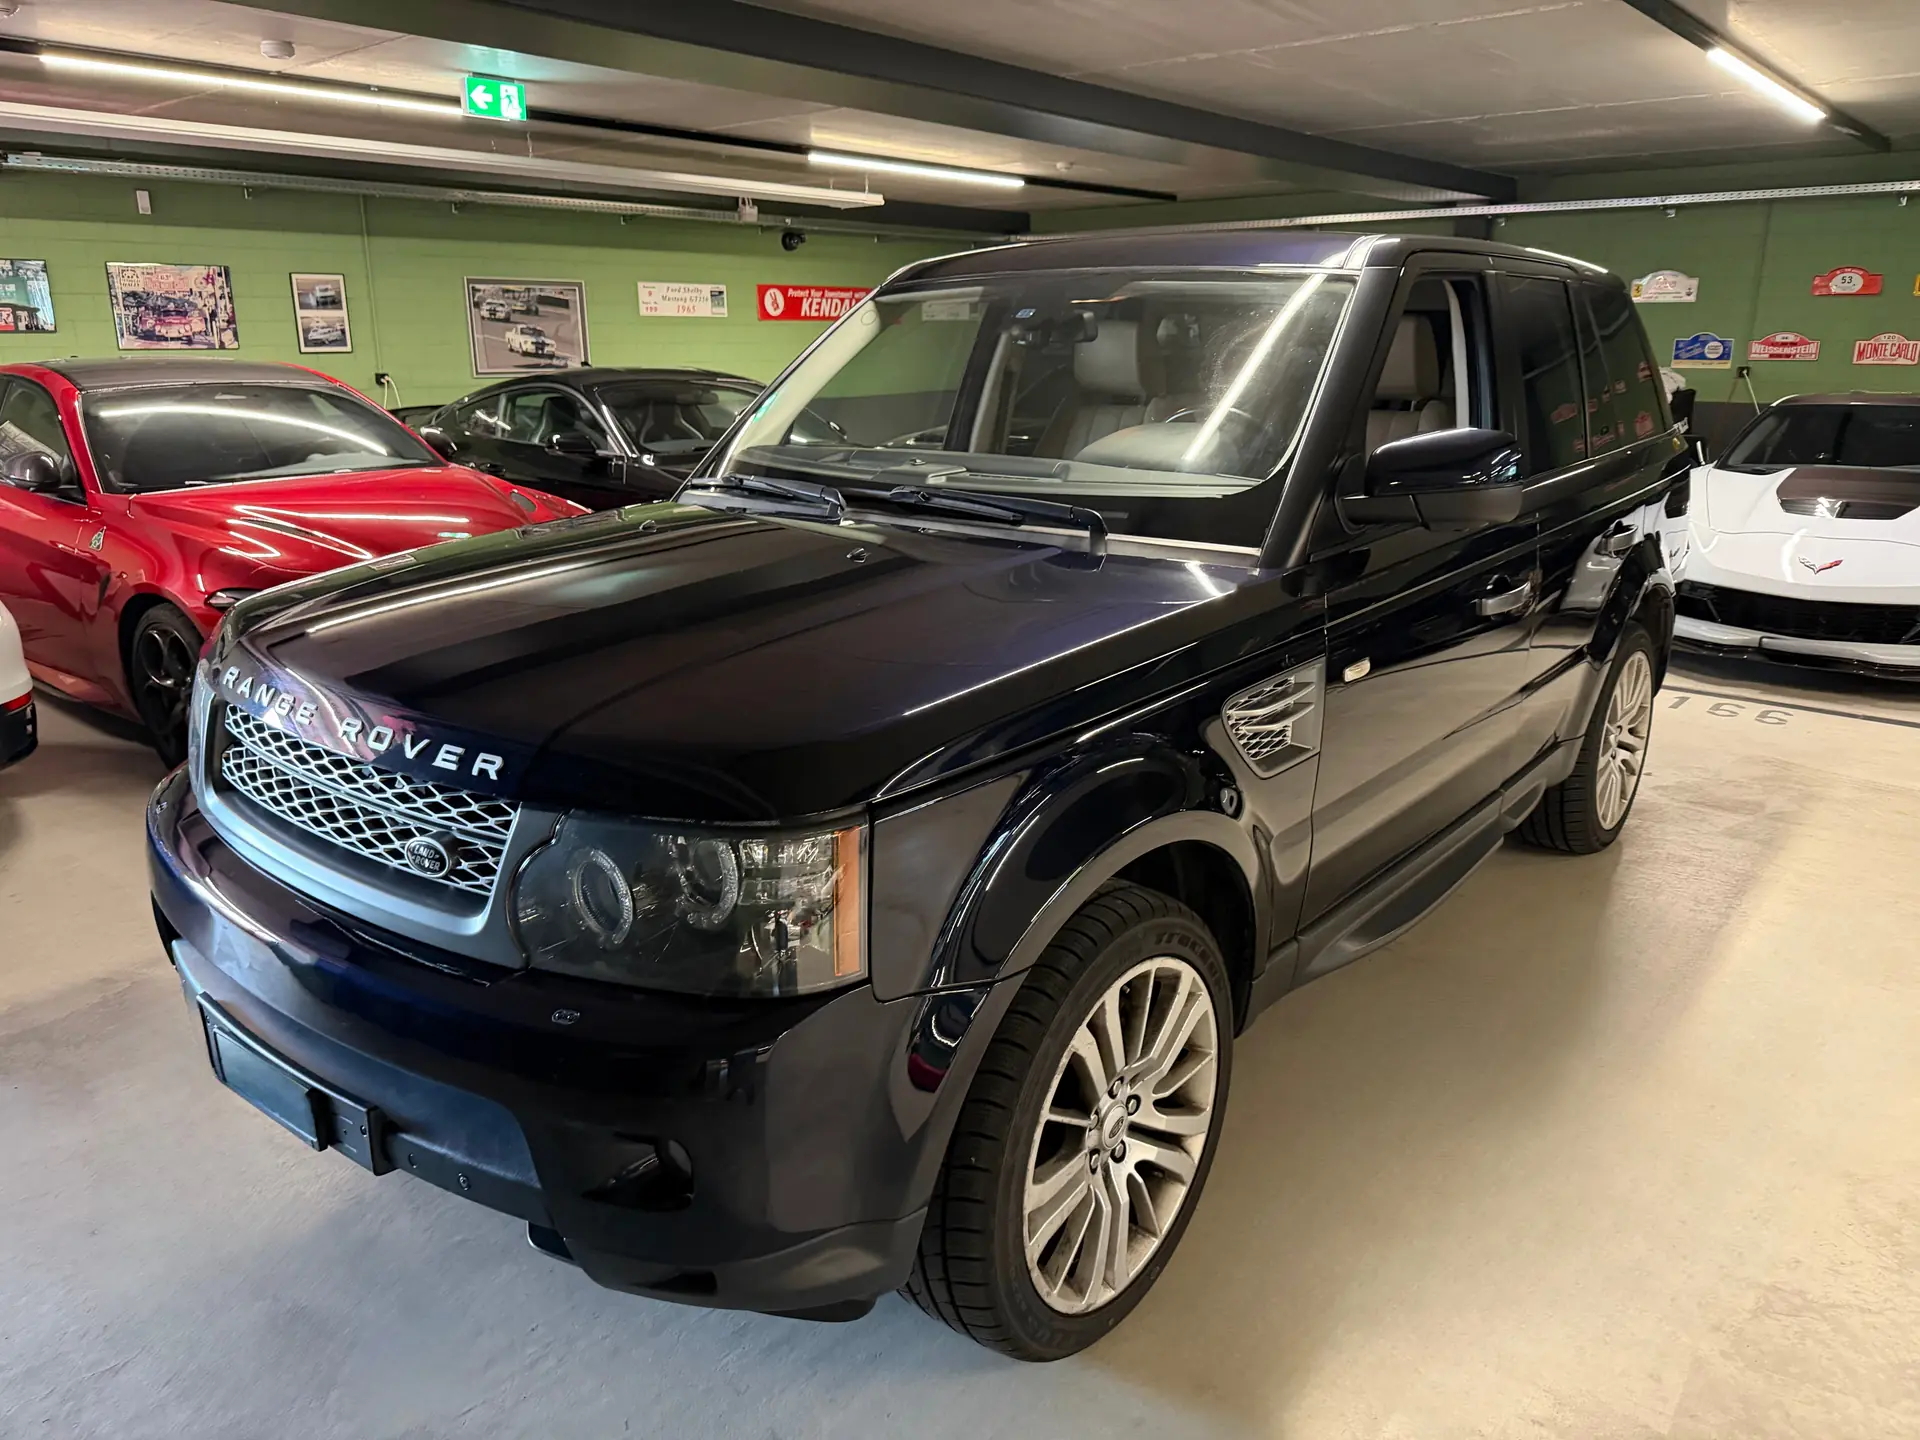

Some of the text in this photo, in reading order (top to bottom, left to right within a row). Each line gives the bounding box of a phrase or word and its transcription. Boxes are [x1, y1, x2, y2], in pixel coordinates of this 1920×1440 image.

[1841, 275, 1853, 284] 53
[682, 286, 703, 294] Shelby
[661, 295, 687, 303] Mustang
[677, 305, 696, 314] 1965
[1751, 342, 1818, 354] WEISSENSTEIN
[1856, 342, 1918, 362] MONTE CARLO
[1668, 696, 1794, 725] 166
[222, 665, 504, 780] RANGE ROVER
[414, 844, 441, 871] LAND ROVER
